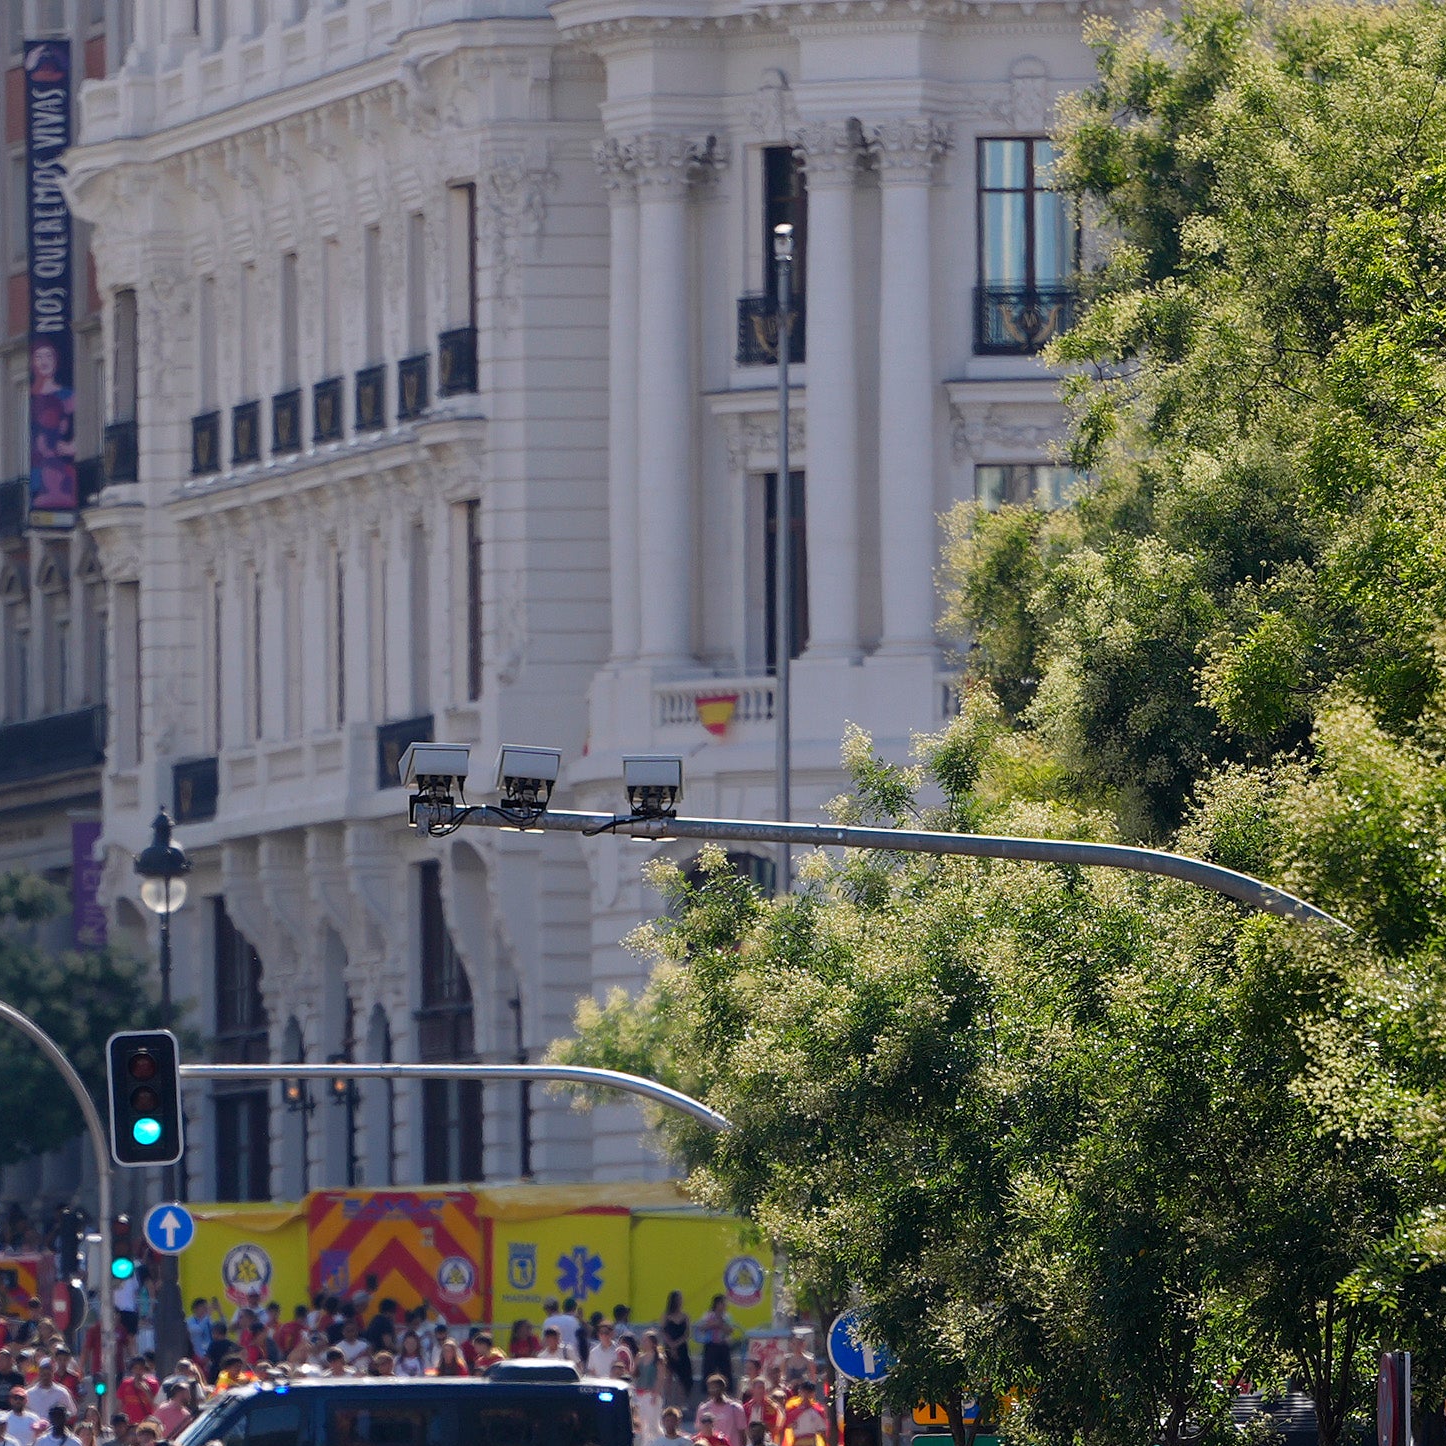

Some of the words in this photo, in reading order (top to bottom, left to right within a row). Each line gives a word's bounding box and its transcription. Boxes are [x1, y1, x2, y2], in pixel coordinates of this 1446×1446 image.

[33, 87, 67, 151] VIVAS
[34, 155, 68, 279] QUEREMOS
[37, 286, 64, 333] NOS
